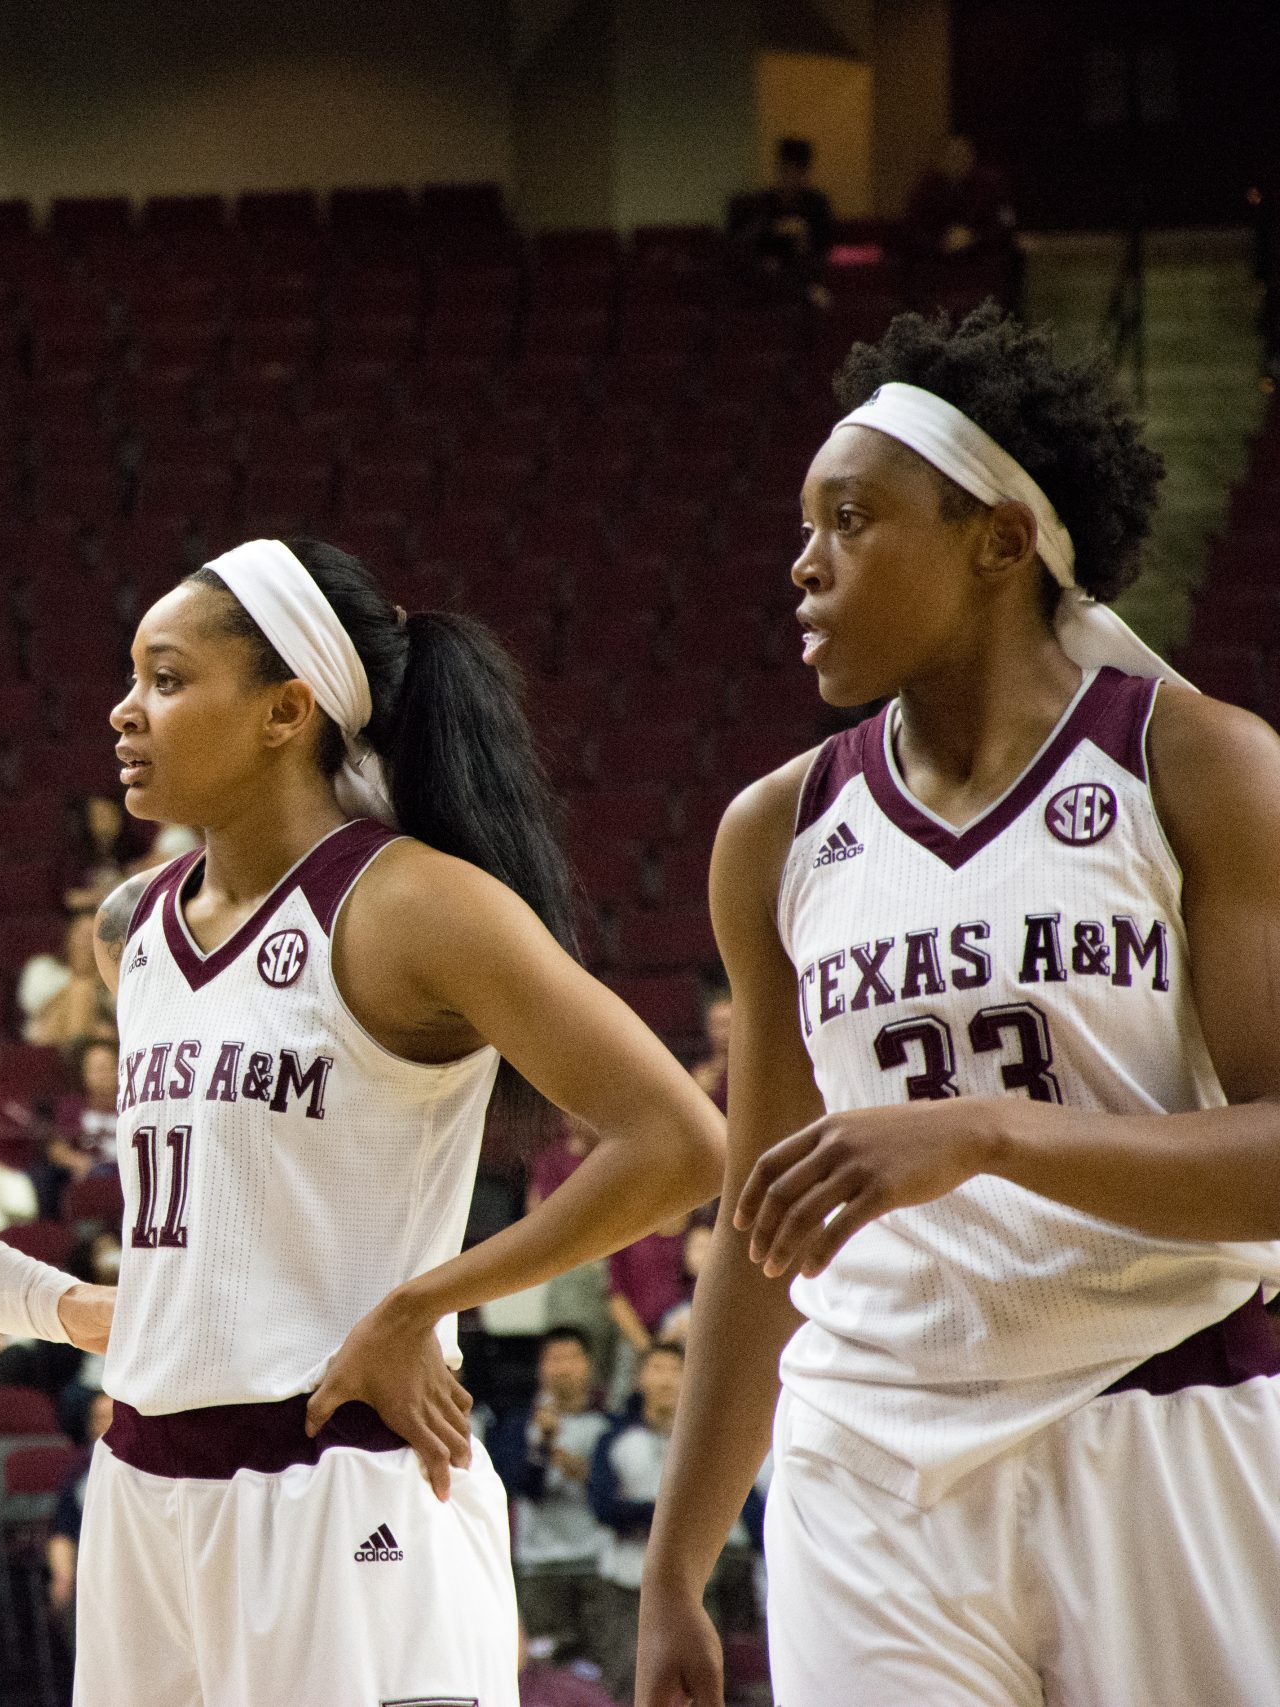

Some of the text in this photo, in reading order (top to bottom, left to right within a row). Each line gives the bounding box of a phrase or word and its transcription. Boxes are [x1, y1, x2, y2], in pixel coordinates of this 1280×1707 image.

[1052, 786, 1111, 841] SEC
[813, 843, 864, 869] adidas
[261, 932, 304, 983] SEC
[799, 912, 1169, 1037] TEXAS A&M
[206, 1041, 333, 1120] A&M
[874, 1001, 1063, 1104] 33
[132, 1125, 192, 1248] 11
[354, 1548, 404, 1562] adidas
